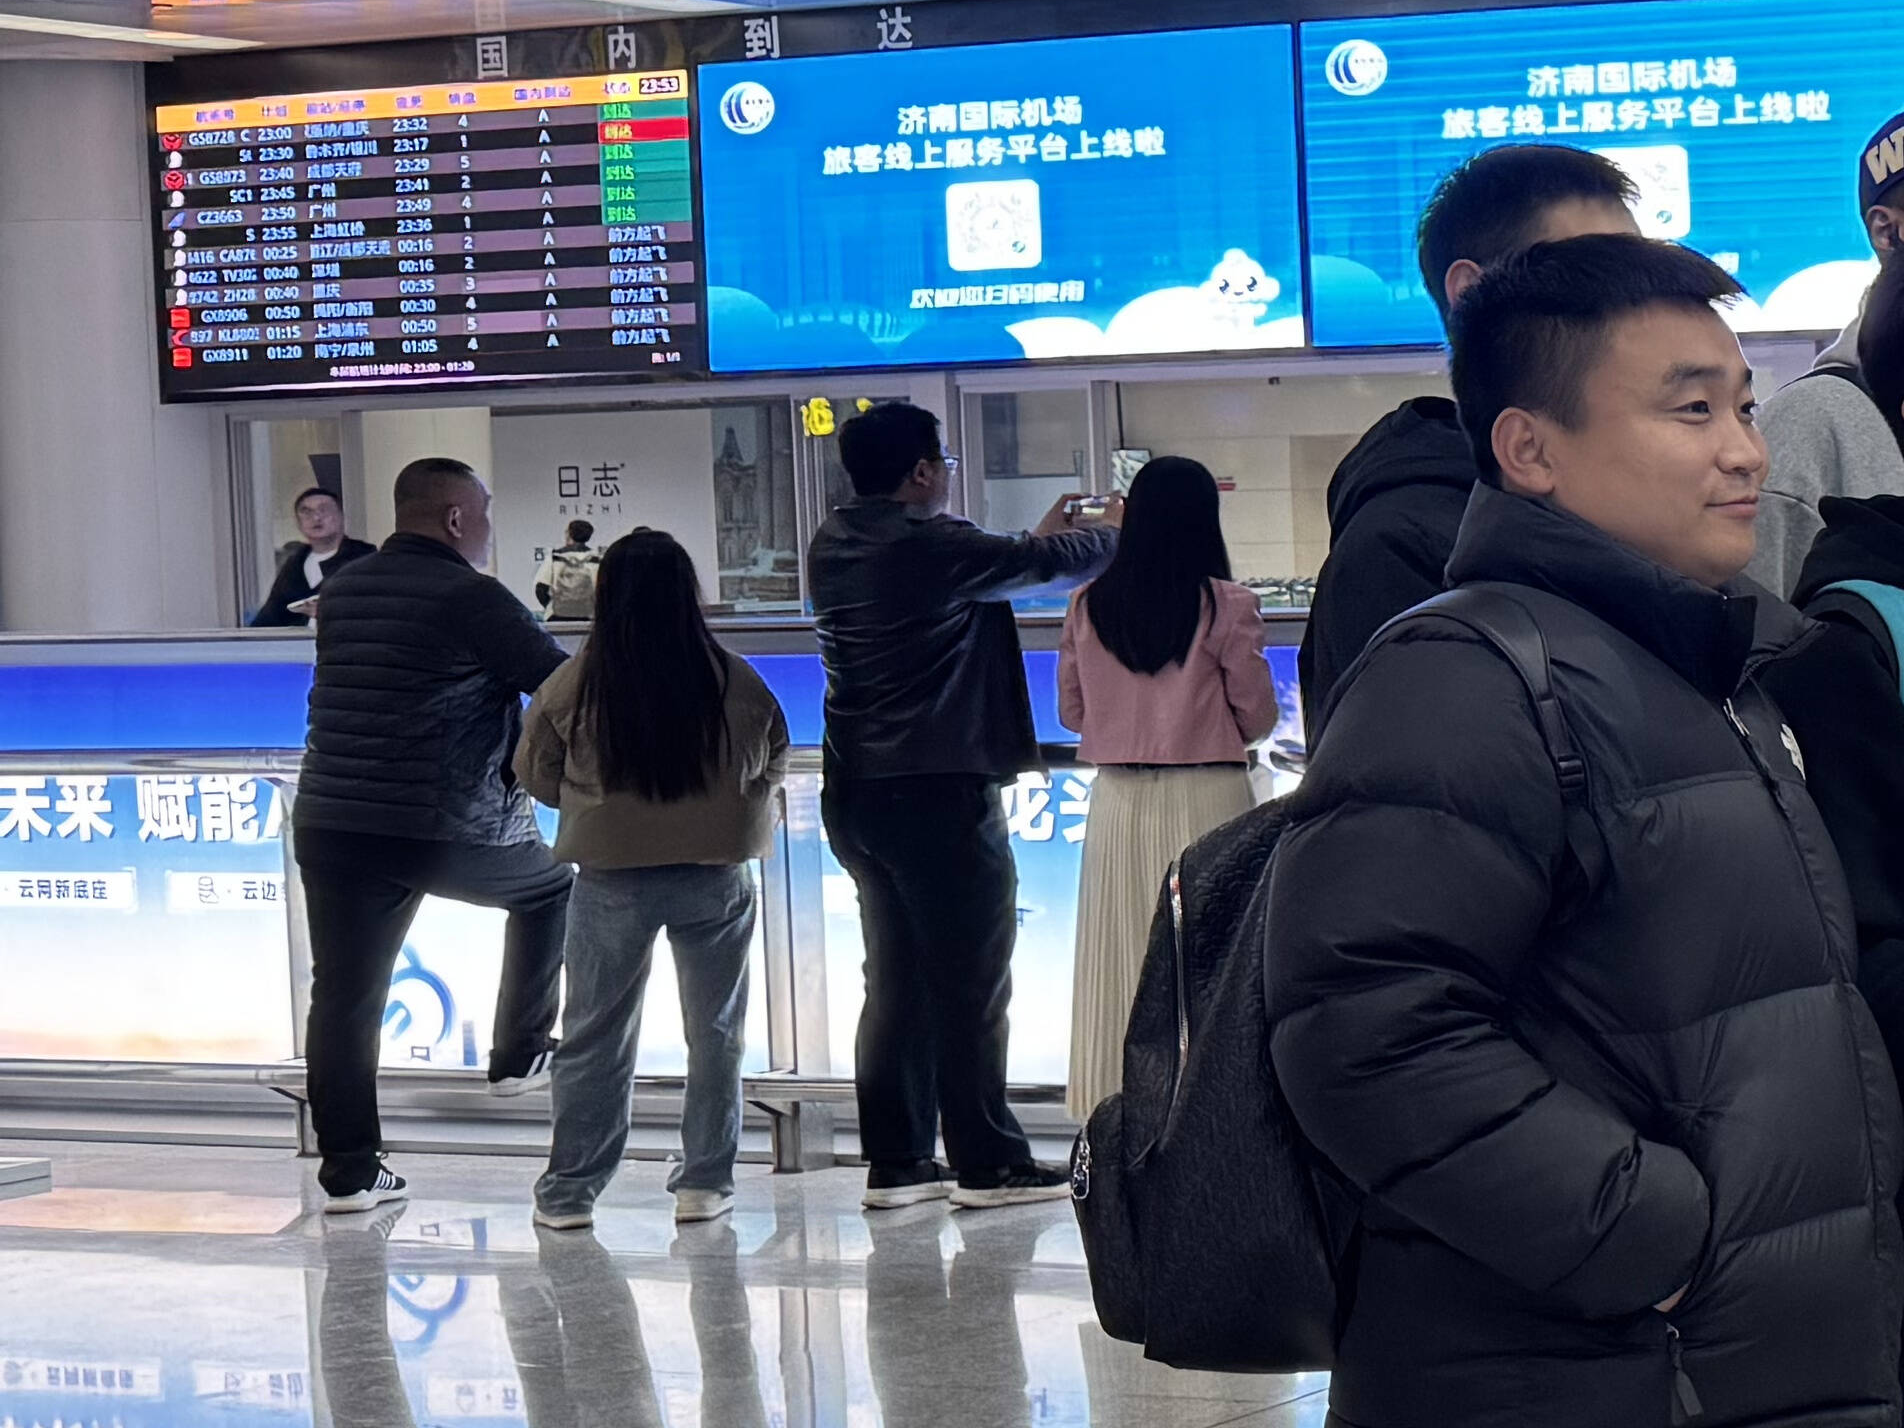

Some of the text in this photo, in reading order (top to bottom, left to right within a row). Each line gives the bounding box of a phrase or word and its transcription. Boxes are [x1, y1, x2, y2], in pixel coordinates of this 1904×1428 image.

[476, 6, 913, 78] 国内到达
[640, 78, 680, 92] 23:53
[1527, 56, 1738, 99] 济南国际机场
[257, 127, 292, 142] 23:00
[392, 118, 428, 133] 23:32
[458, 114, 468, 128] 4
[538, 108, 550, 122] A
[897, 96, 1083, 135] 济南国际机场
[1441, 91, 1831, 140] 旅客线上服务平台上线啦
[259, 147, 294, 162] 23:30
[393, 138, 429, 153] 23:17
[460, 134, 467, 148] 1
[538, 128, 551, 143] A
[822, 127, 1166, 174] 旅客线上服务平台上线啦
[259, 167, 294, 182] 23:40
[394, 158, 430, 173] 23:29
[460, 155, 470, 169] 5
[539, 150, 552, 164] A
[307, 183, 336, 199] 广州
[395, 178, 430, 193] 23:41
[461, 176, 471, 189] 2
[540, 170, 553, 184] A
[605, 165, 634, 180] 到达
[261, 206, 296, 221] 23:50
[309, 203, 336, 219] 广州
[396, 199, 432, 213] 23:49
[461, 196, 472, 210] 4
[541, 190, 553, 205] A
[607, 185, 635, 201] 到达
[262, 225, 297, 240] 23:55
[397, 218, 432, 233] 23:36
[464, 215, 471, 229] 1
[542, 210, 554, 225] A
[607, 205, 636, 222] 到达
[263, 246, 297, 261] 00:25
[397, 238, 433, 253] 00:16
[464, 236, 473, 250] 2
[543, 231, 554, 246] A
[263, 266, 298, 281] 00:40
[399, 259, 434, 273] 00:16
[464, 256, 474, 270] 2
[544, 252, 555, 266] A
[264, 286, 299, 301] 00:40
[399, 279, 435, 293] 00:35
[465, 276, 475, 290] 3
[545, 272, 556, 287] A
[265, 306, 300, 321] 00:50
[400, 299, 436, 313] 00:30
[465, 296, 476, 310] 4
[545, 292, 557, 306] A
[266, 326, 302, 340] 01:15
[401, 320, 437, 334] 00:50
[467, 317, 477, 331] 5
[546, 313, 557, 327] A
[267, 346, 302, 360] 01:20
[402, 339, 438, 354] 01:05
[467, 337, 478, 351] 4
[547, 333, 559, 347] A
[558, 461, 625, 498] 日志
[242, 880, 286, 901] 云边
